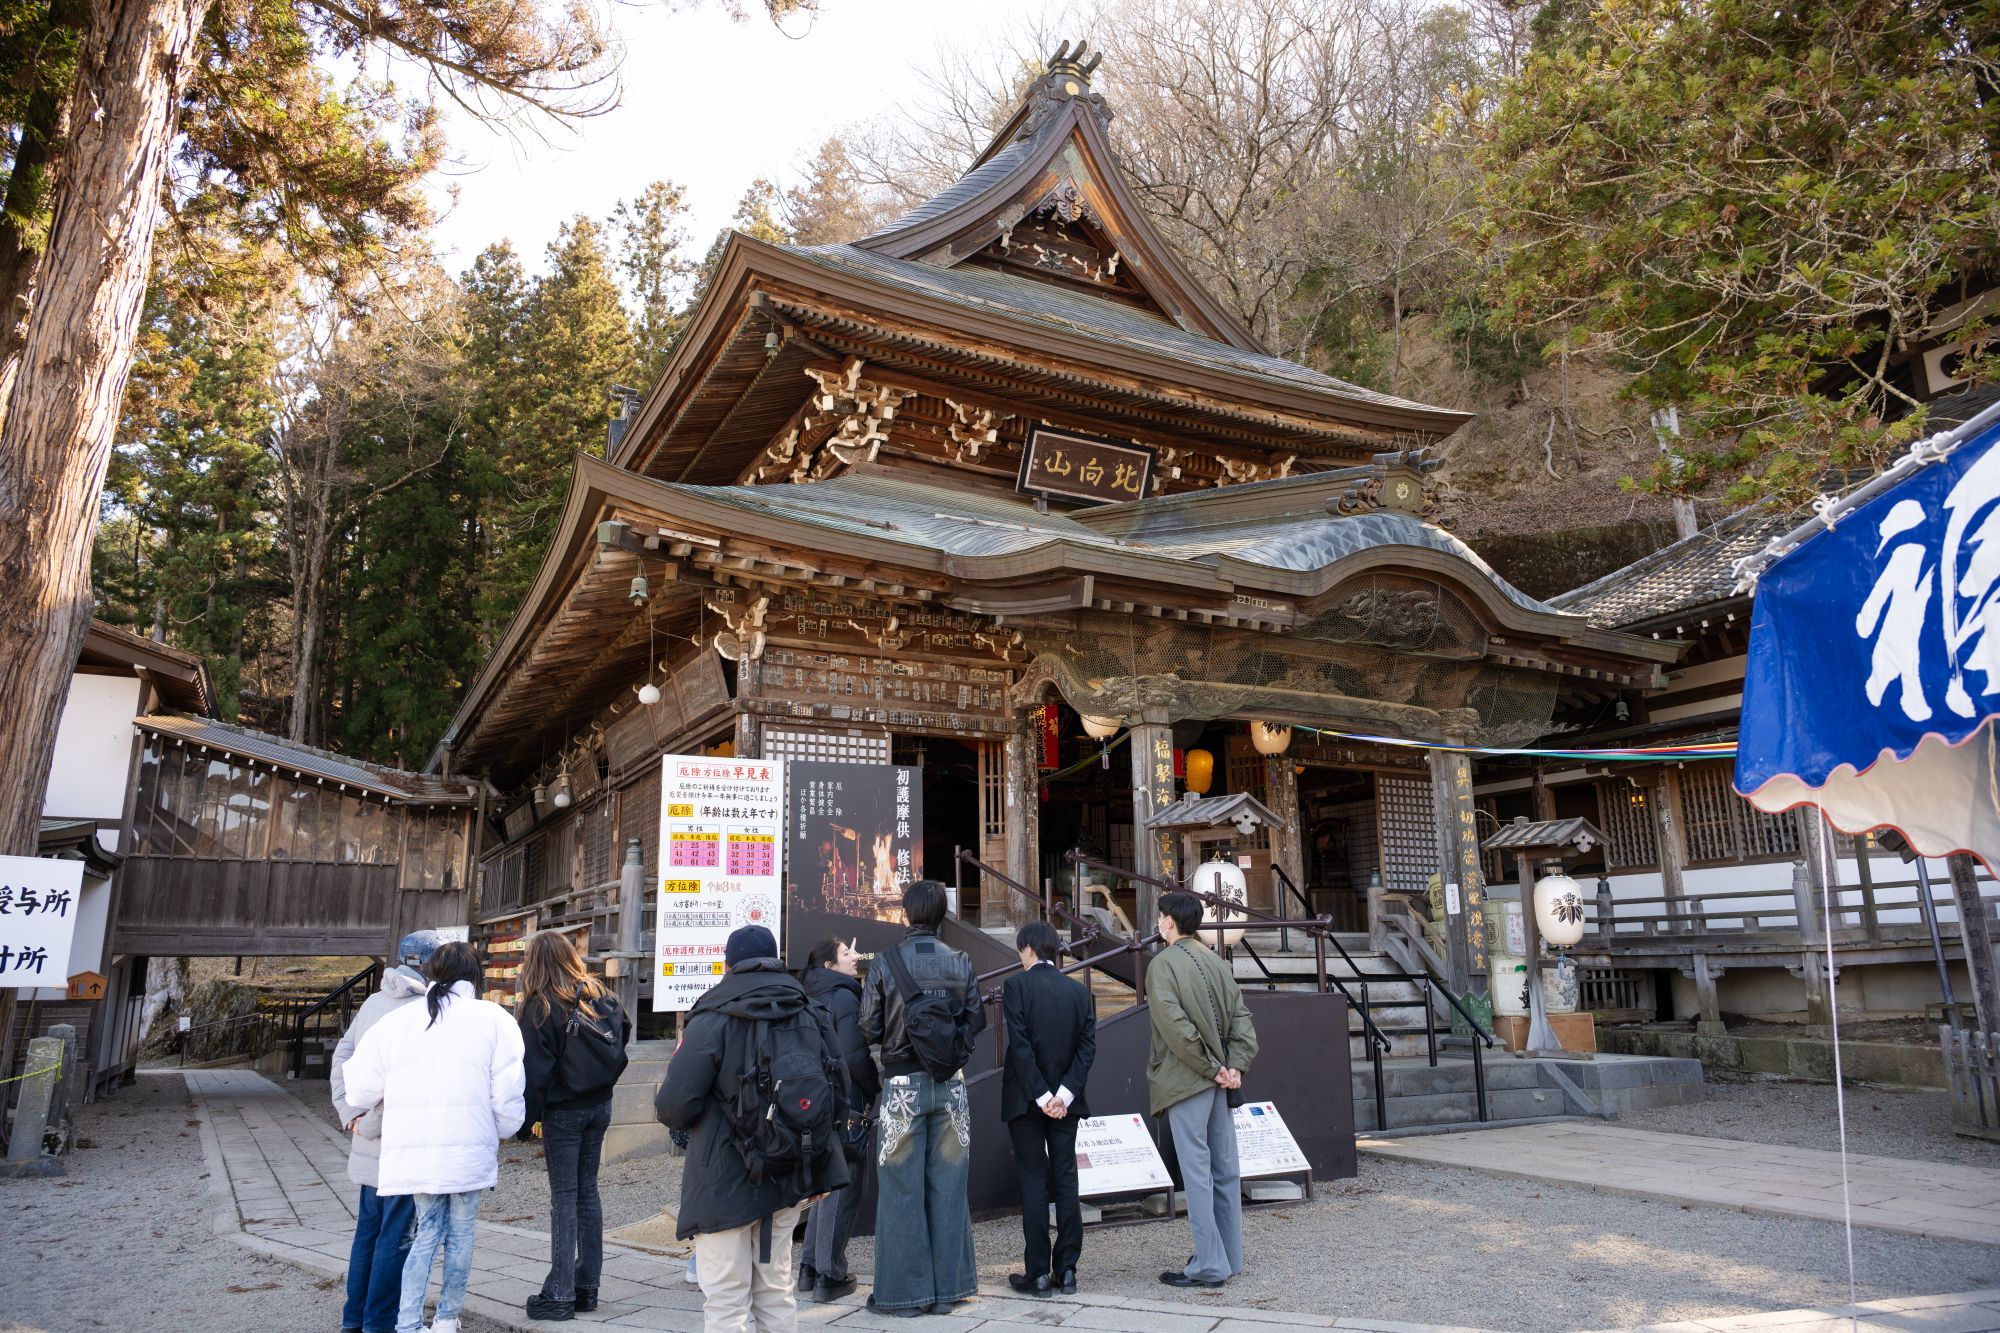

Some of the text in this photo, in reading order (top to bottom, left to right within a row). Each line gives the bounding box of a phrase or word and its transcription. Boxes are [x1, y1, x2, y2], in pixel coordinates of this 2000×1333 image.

[826, 781, 834, 816] 家内安全
[669, 805, 692, 816] 厄除
[895, 769, 910, 884] 初護摩供 修法
[666, 881, 698, 892] 方位除
[675, 964, 685, 974] 7時
[701, 964, 712, 973] 11時
